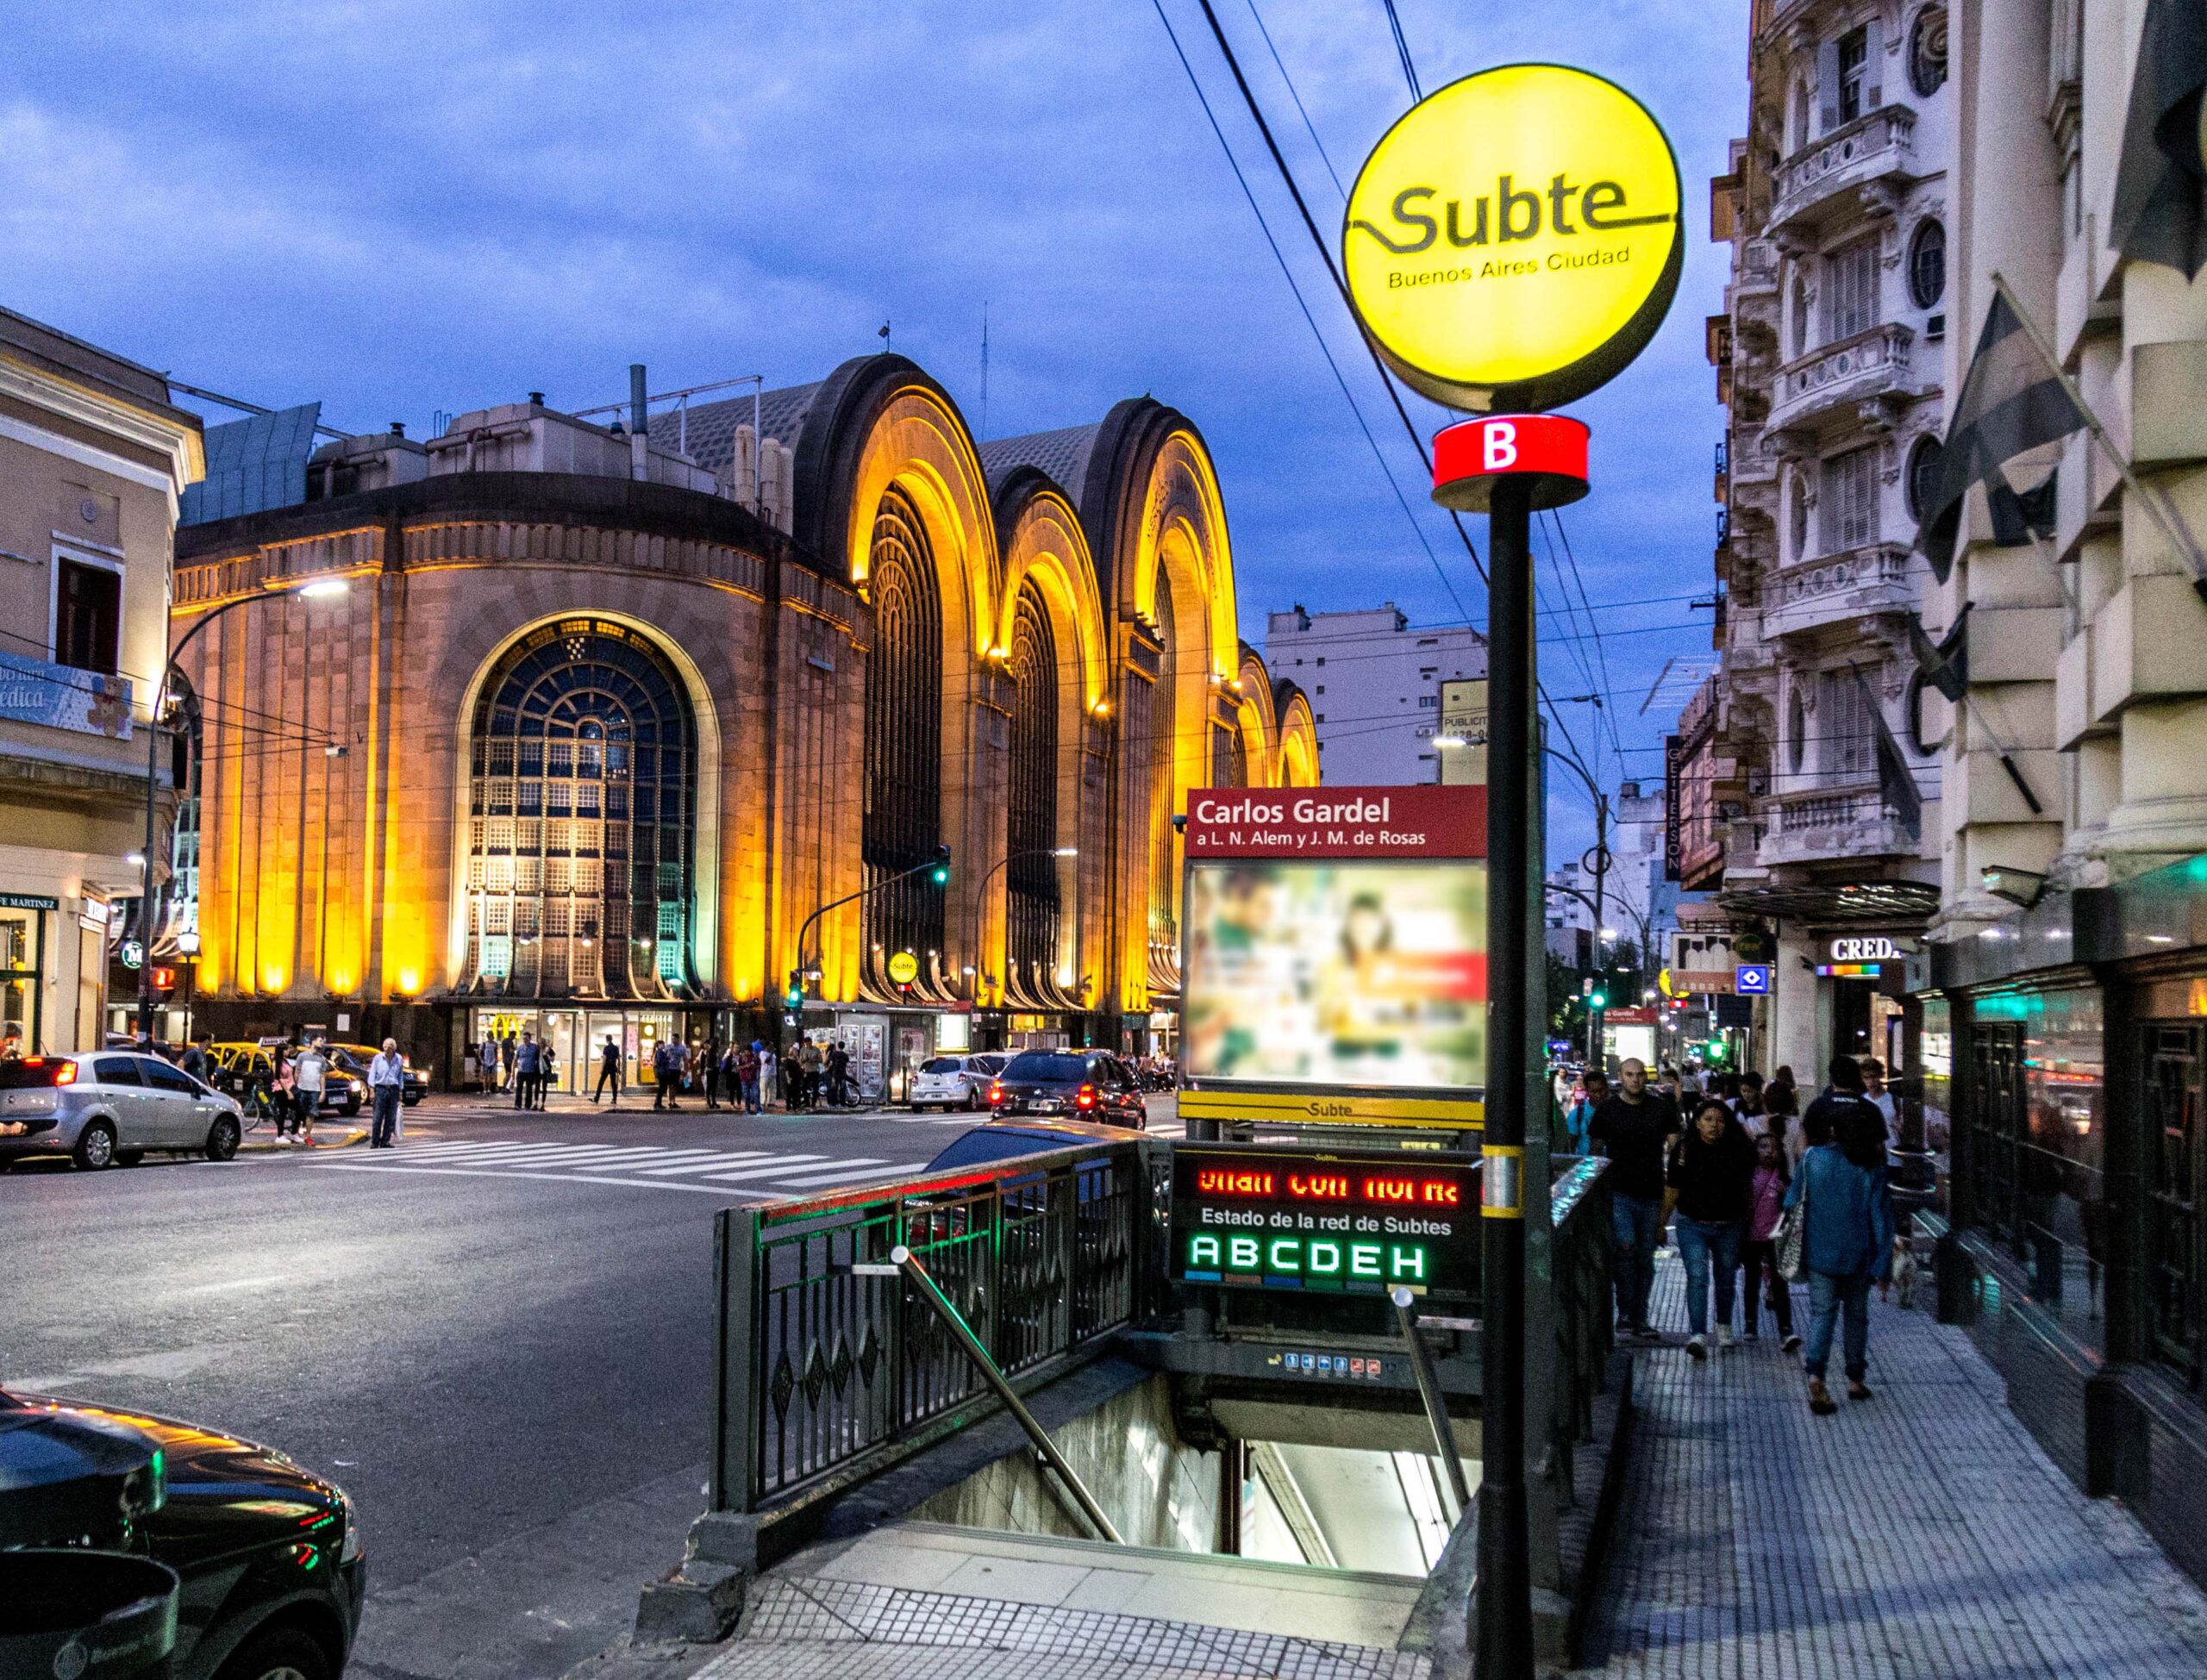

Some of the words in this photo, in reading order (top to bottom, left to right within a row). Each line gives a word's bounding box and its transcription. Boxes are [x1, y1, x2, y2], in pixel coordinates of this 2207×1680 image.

[1353, 173, 1670, 254] Subte
[1389, 265, 1472, 290] Buenos
[1480, 259, 1539, 280] Aires
[1547, 245, 1630, 271] Ciudad
[1483, 422, 1518, 471] B
[1196, 798, 1285, 825] Carlos
[1293, 797, 1391, 824] Gardel
[1197, 834, 1207, 846] a
[1211, 831, 1223, 846] L.
[1229, 831, 1246, 846] N.
[1250, 830, 1292, 846] Alem
[1297, 834, 1306, 848] y
[1310, 831, 1321, 846] J.
[1327, 831, 1348, 845] M.
[1354, 830, 1373, 845] de
[1379, 831, 1426, 846] Rosas
[1307, 1102, 1354, 1117] Subte
[1201, 1208, 1265, 1226] Estado
[1270, 1212, 1293, 1227] de
[1297, 1212, 1314, 1228] la
[1320, 1215, 1350, 1231] red
[1354, 1215, 1379, 1233] de
[1385, 1217, 1452, 1235] Subtes
